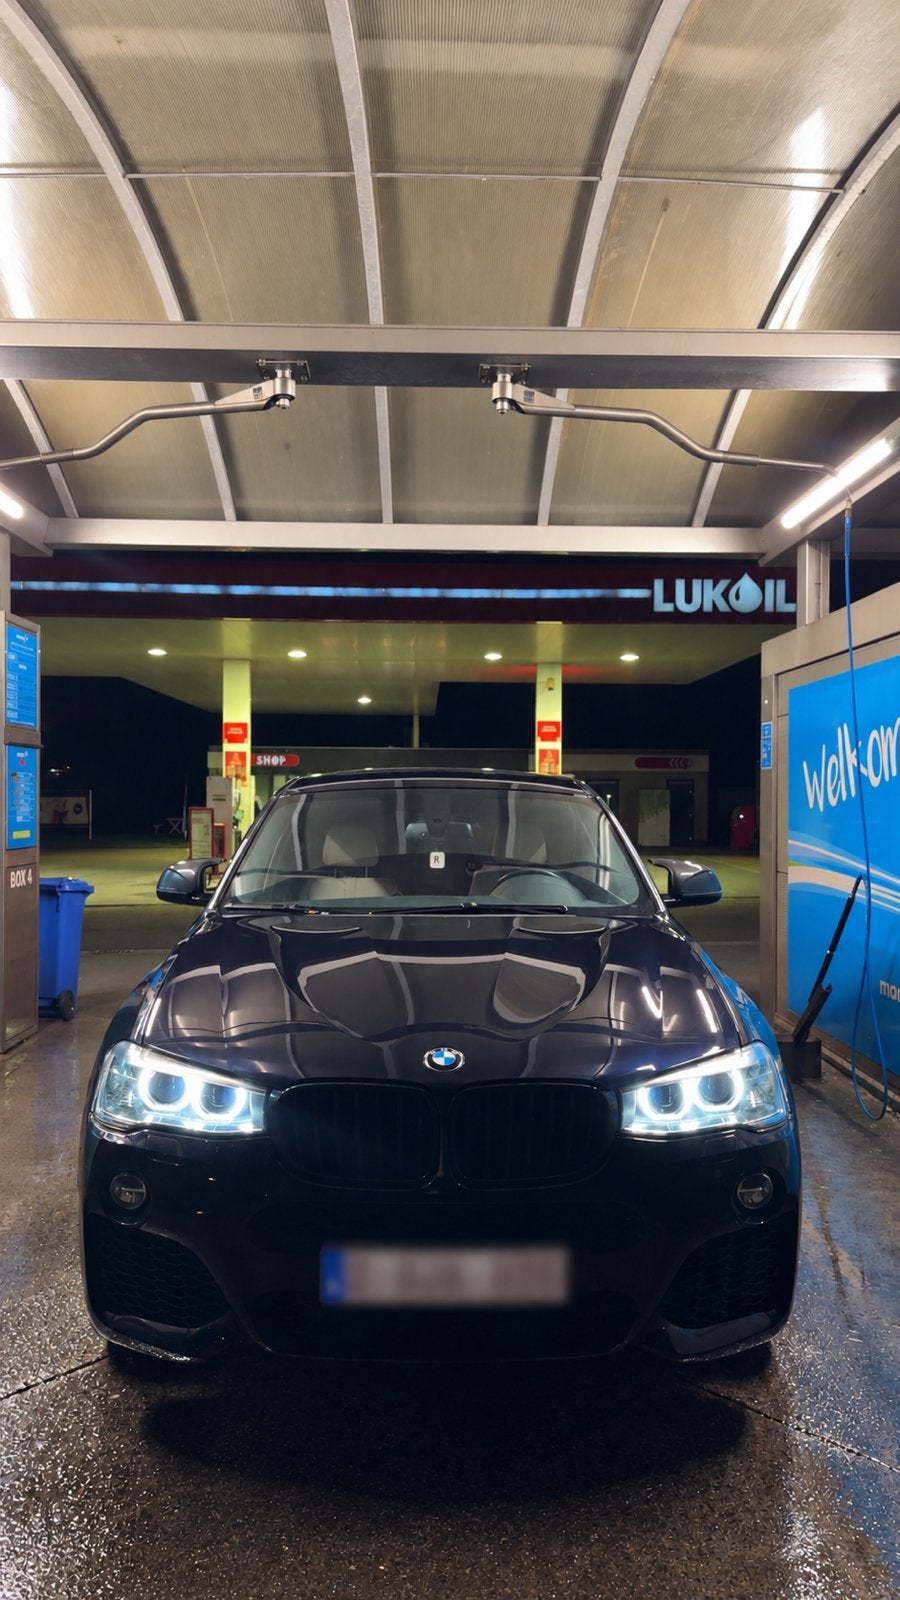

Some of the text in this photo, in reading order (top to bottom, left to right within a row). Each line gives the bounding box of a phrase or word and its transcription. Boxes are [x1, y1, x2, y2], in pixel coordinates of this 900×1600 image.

[653, 572, 797, 613] LUKOIL
[256, 755, 286, 766] SHOP
[10, 868, 33, 888] BOX 4
